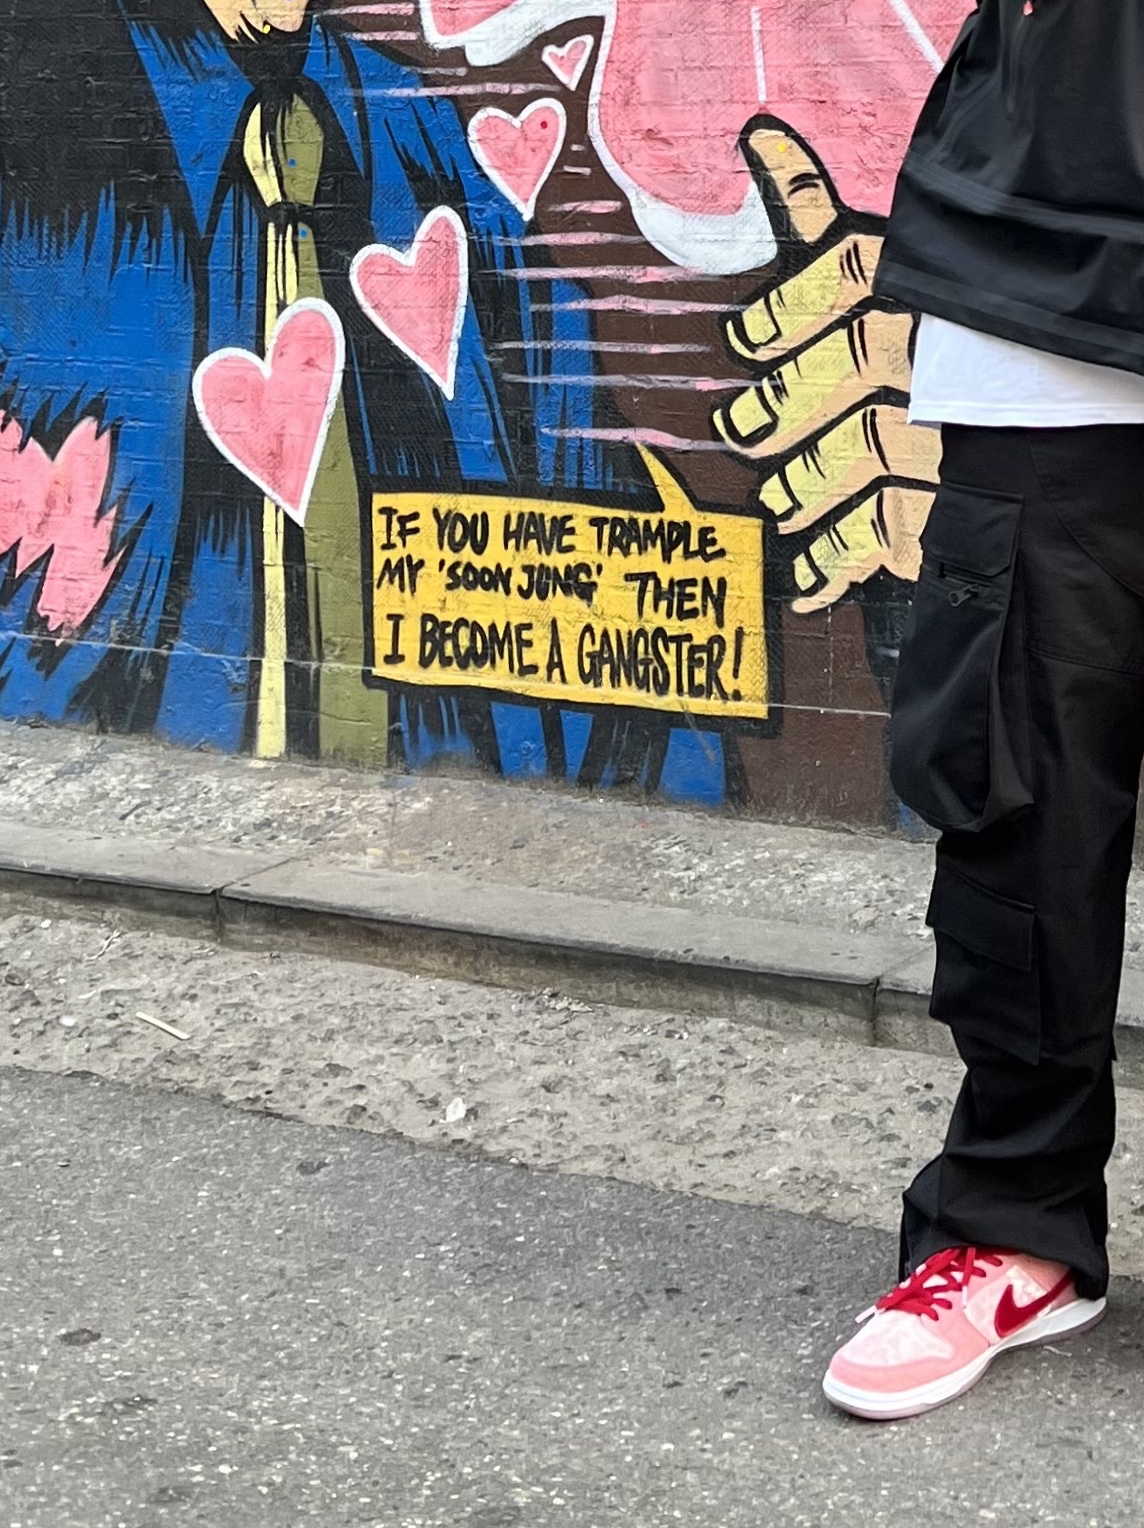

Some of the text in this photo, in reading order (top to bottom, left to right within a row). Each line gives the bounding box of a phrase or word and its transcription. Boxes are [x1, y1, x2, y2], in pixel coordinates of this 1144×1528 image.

[377, 506, 727, 564] IF YOU HAVE TRAMPLE
[376, 554, 425, 597] MY
[624, 572, 727, 628] THEN
[383, 613, 744, 703] I BECOME A GANGSTER!
